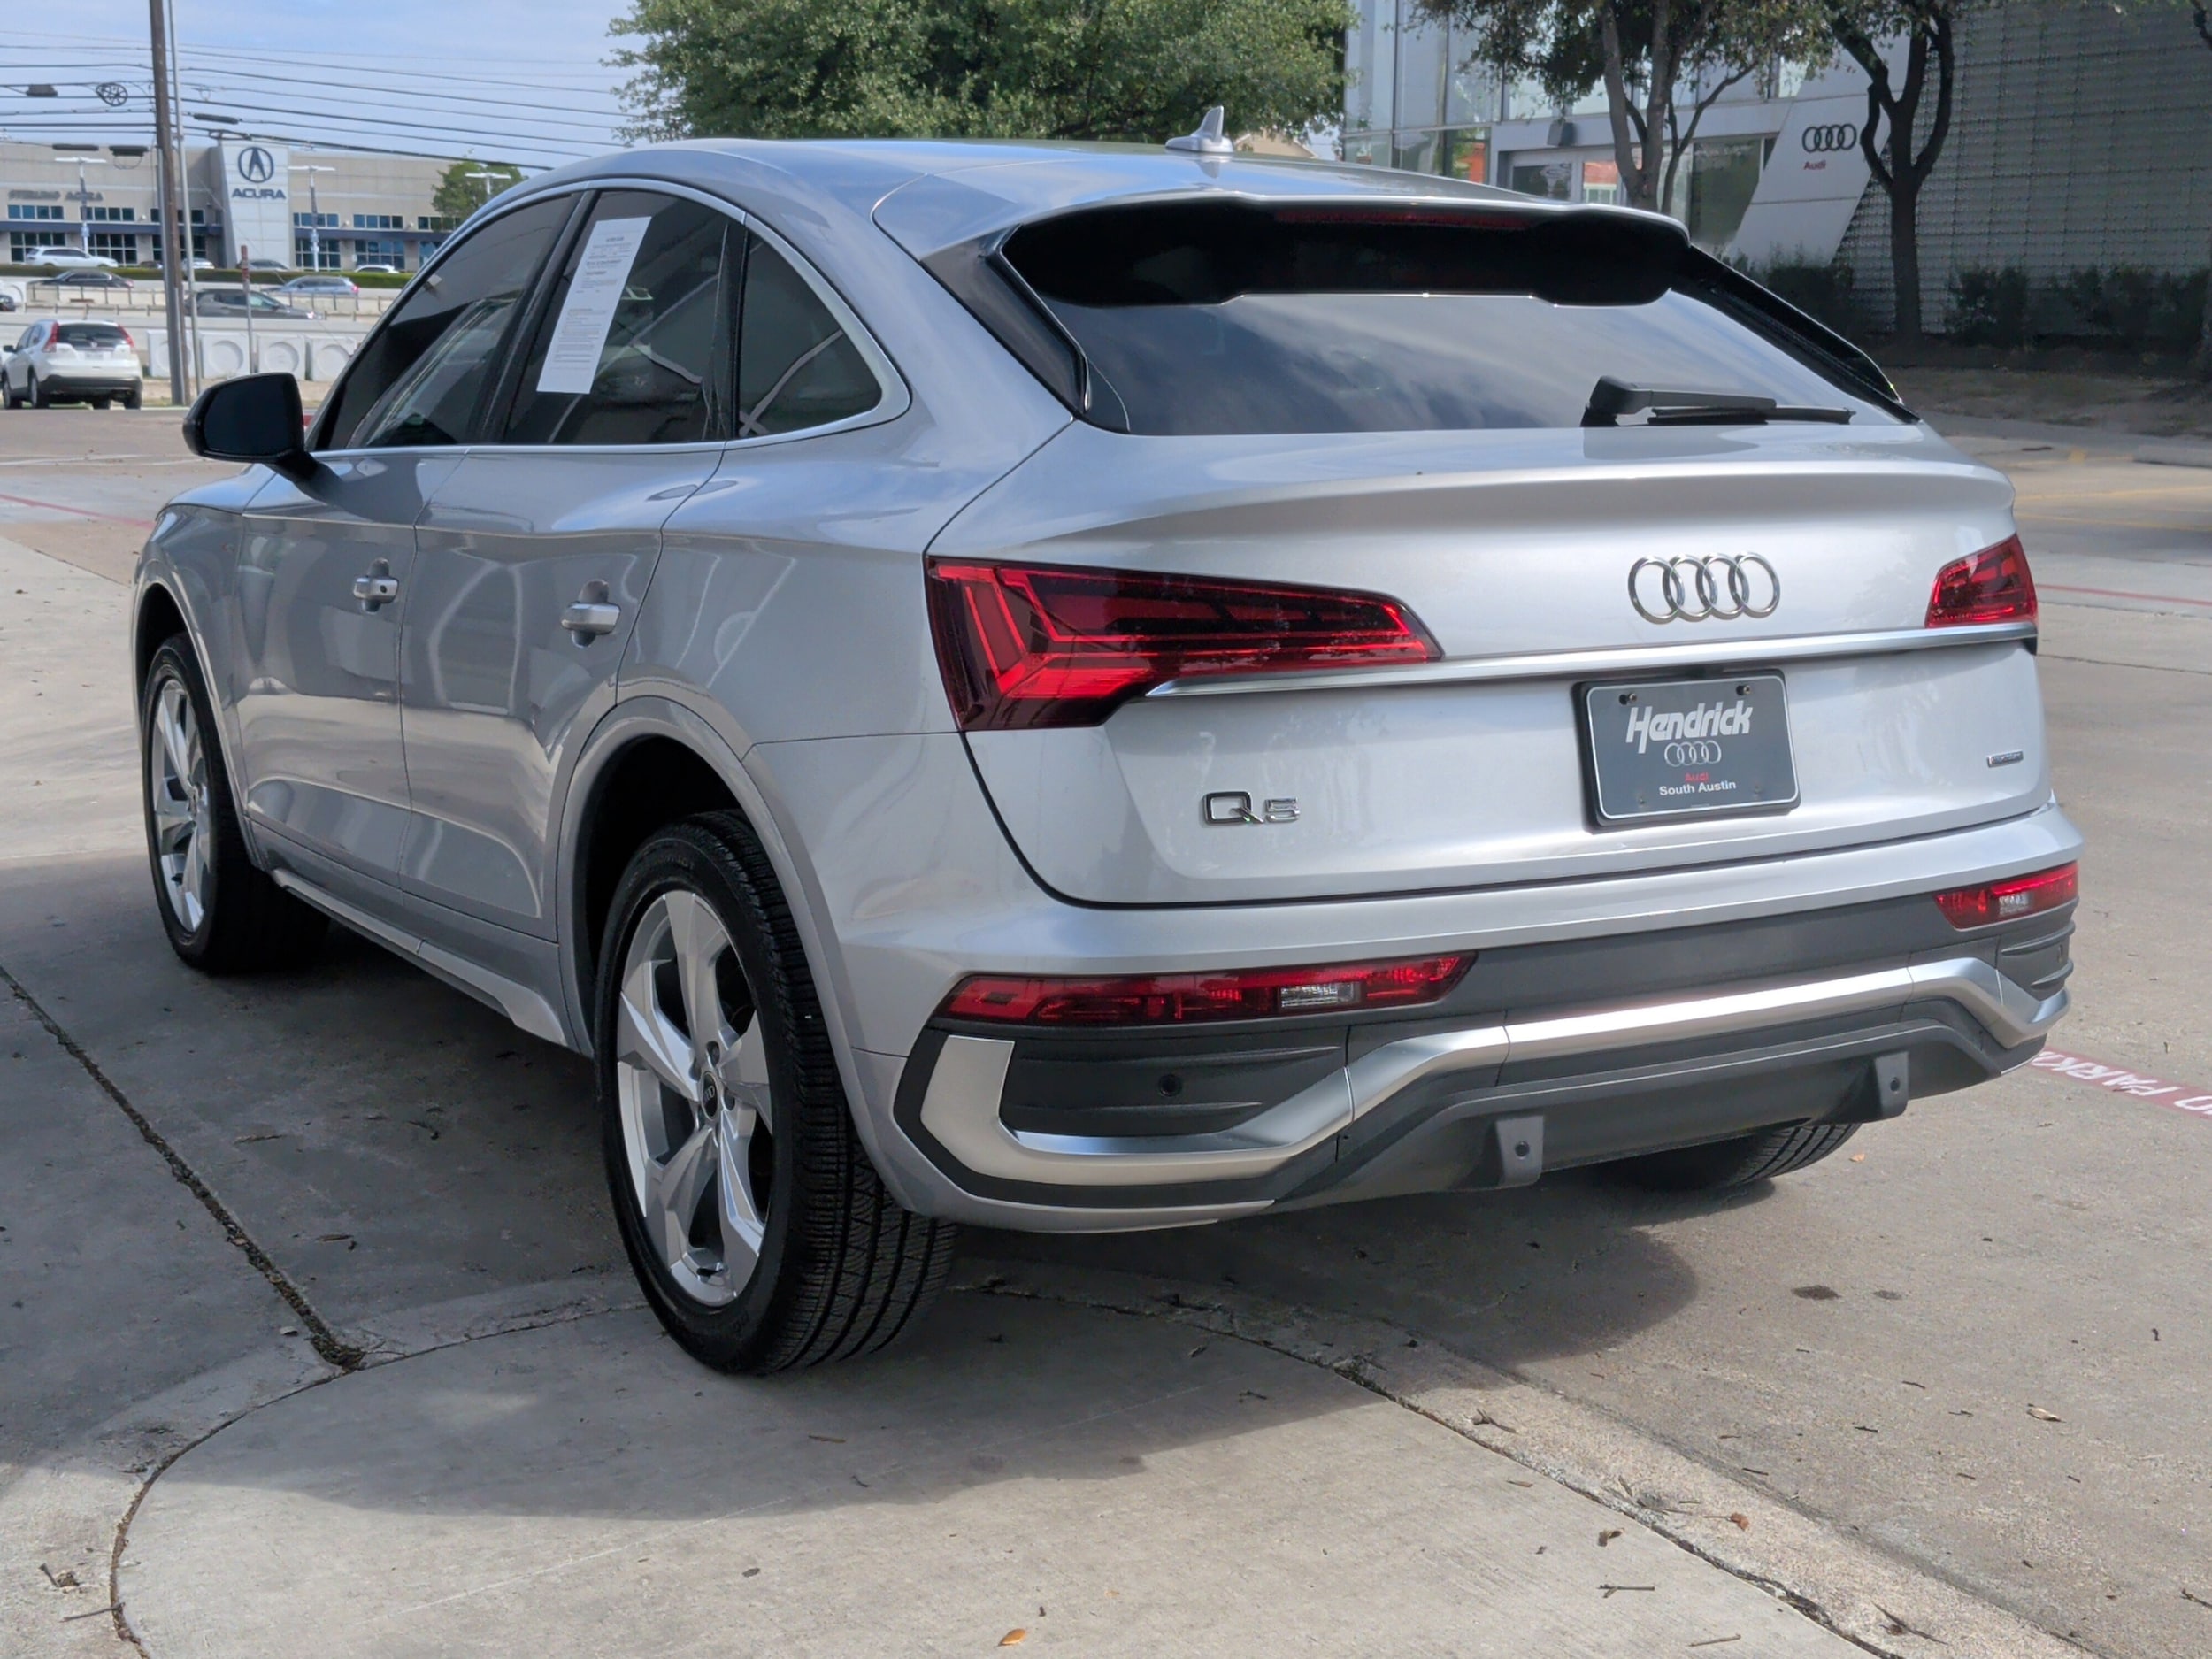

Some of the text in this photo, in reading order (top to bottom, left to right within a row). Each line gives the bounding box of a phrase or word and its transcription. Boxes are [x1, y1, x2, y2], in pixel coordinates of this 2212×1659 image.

[1803, 159, 1826, 170] Audi
[232, 188, 287, 200] ACURA
[1625, 700, 1753, 754] Hendrick
[1685, 772, 1709, 782] Audi
[1659, 780, 1736, 796] South Austin
[1202, 790, 1301, 825] Q5
